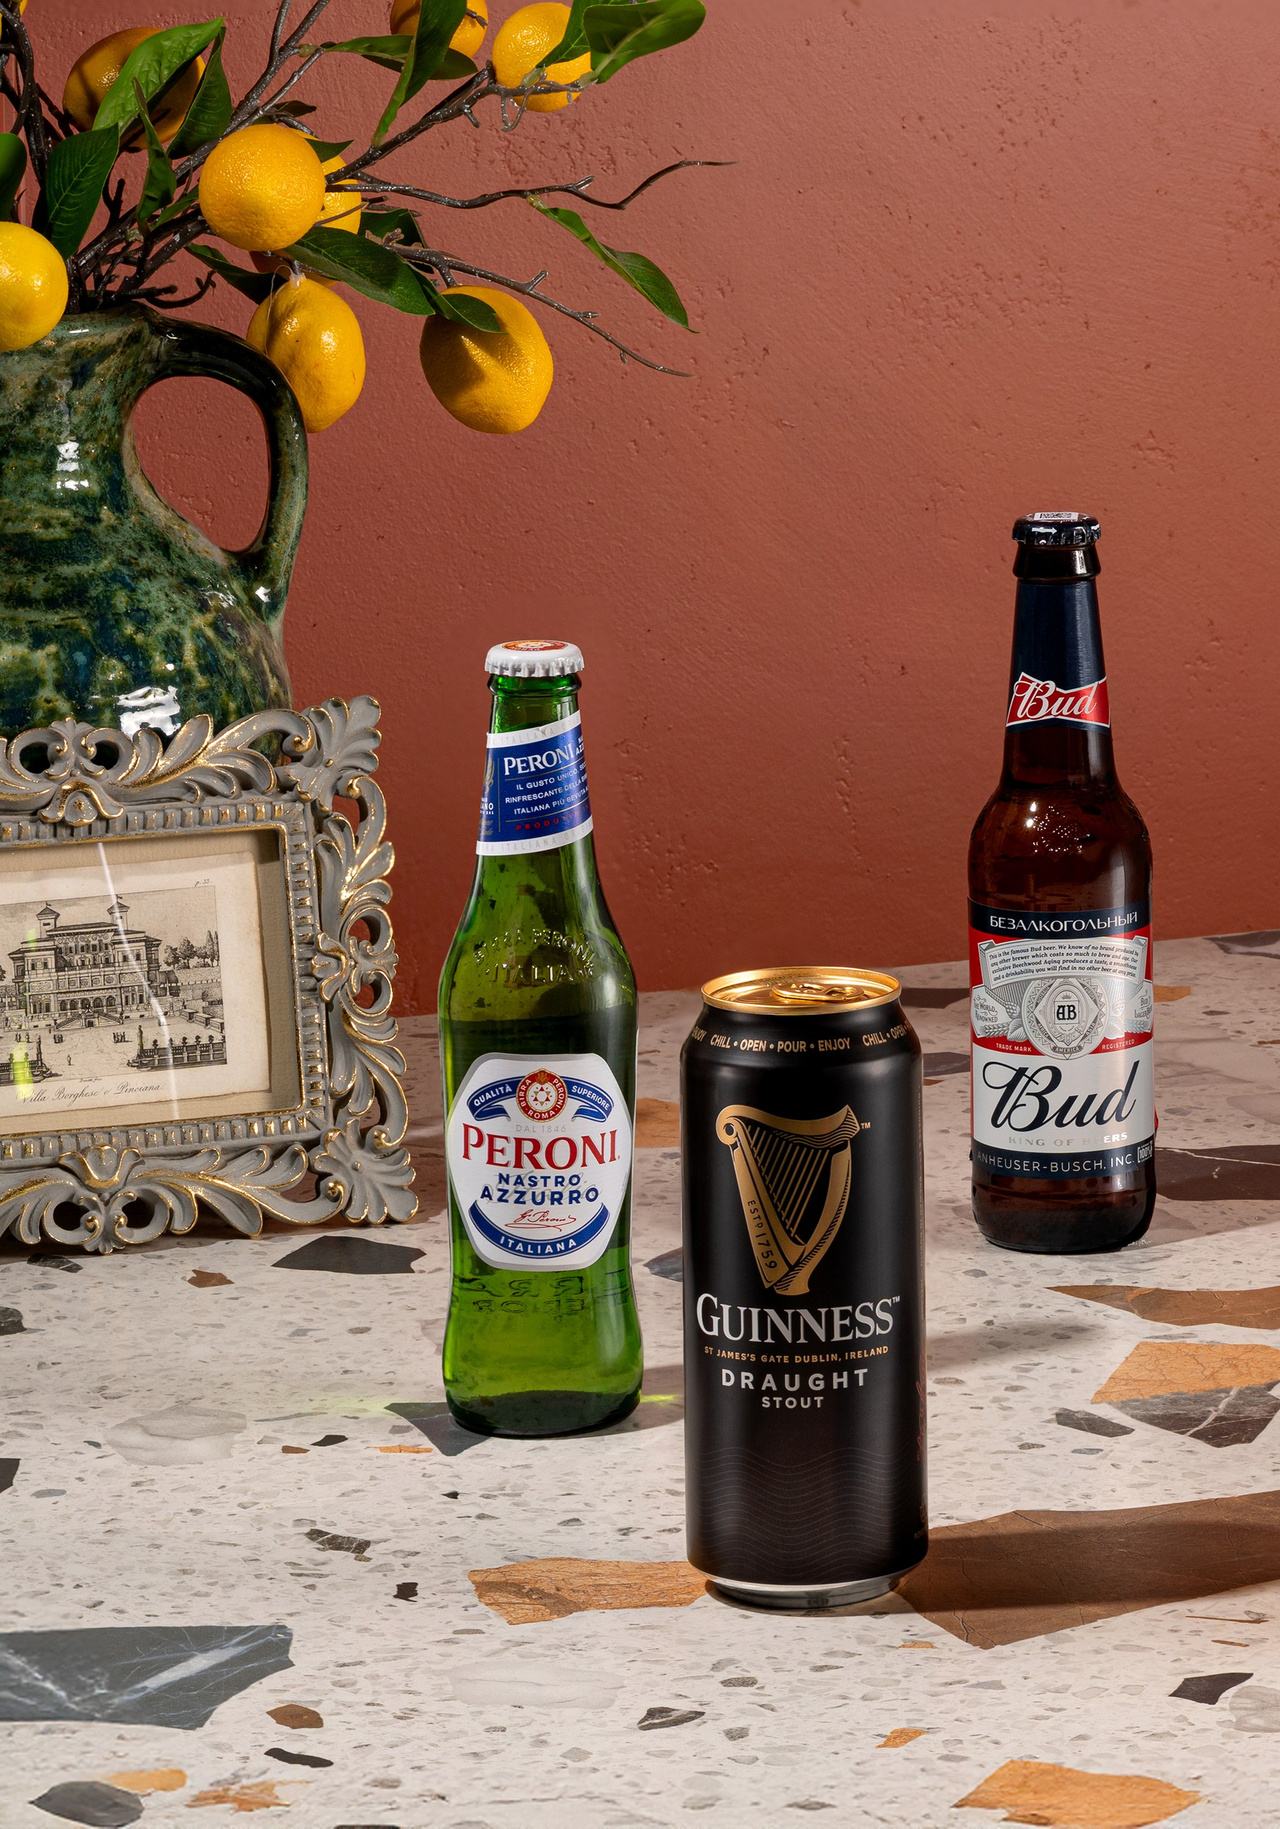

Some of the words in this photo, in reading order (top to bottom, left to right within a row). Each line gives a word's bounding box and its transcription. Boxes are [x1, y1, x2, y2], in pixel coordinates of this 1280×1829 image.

[1013, 680, 1098, 720] Bud
[503, 743, 574, 775] PERONI
[505, 787, 562, 804] RINFRESCANTE
[564, 778, 581, 791] DELLA
[526, 777, 555, 790] GUSTO
[514, 803, 550, 815] ITALIANA
[552, 796, 565, 808] PIÙ
[566, 789, 585, 802] BEVUTA
[989, 911, 1138, 932] БЕЗАЛКОГОЛЬНЫЙ
[992, 965, 1011, 974] exclusive
[1012, 960, 1042, 969] Beechwood
[1005, 968, 1034, 978] drinkability
[710, 1034, 731, 1049] CHILL
[740, 1038, 767, 1052] OPEN
[777, 1040, 807, 1052] POUR
[818, 1038, 850, 1052] ENJOY
[862, 1031, 887, 1047] CHILL
[890, 1024, 907, 1039] OPEN
[1102, 1038, 1135, 1050] REGISTERED
[1056, 1045, 1080, 1053] AMERICA
[16, 1088, 47, 1104] Villa
[474, 1084, 512, 1107] QUALITÀ
[518, 1079, 532, 1107] BIRRA
[552, 1078, 564, 1109] PERONI
[571, 1085, 610, 1110] SUPERIORE
[982, 1060, 1140, 1132] Bud
[528, 1110, 556, 1119] ROMA
[516, 1124, 537, 1132] DAL
[541, 1124, 567, 1133] 1846
[462, 1123, 618, 1170] PERONI
[1009, 1136, 1045, 1147] KING
[1053, 1138, 1074, 1147] OF
[1110, 1154, 1135, 1168] INC.
[498, 1172, 581, 1187] NASTRO
[480, 1186, 599, 1206] AZZURRO
[500, 1236, 577, 1254] ITALIANA
[755, 1233, 778, 1269] 1759
[696, 1292, 895, 1344] GUINNESS
[704, 1346, 713, 1355] ST
[717, 1349, 756, 1362] JAMES'S
[761, 1355, 789, 1363] GATE
[794, 1353, 841, 1364] DUBLIN,
[845, 1345, 889, 1360] IRELAND
[721, 1368, 868, 1392] DRAUGHT
[761, 1396, 824, 1409] STOUT
